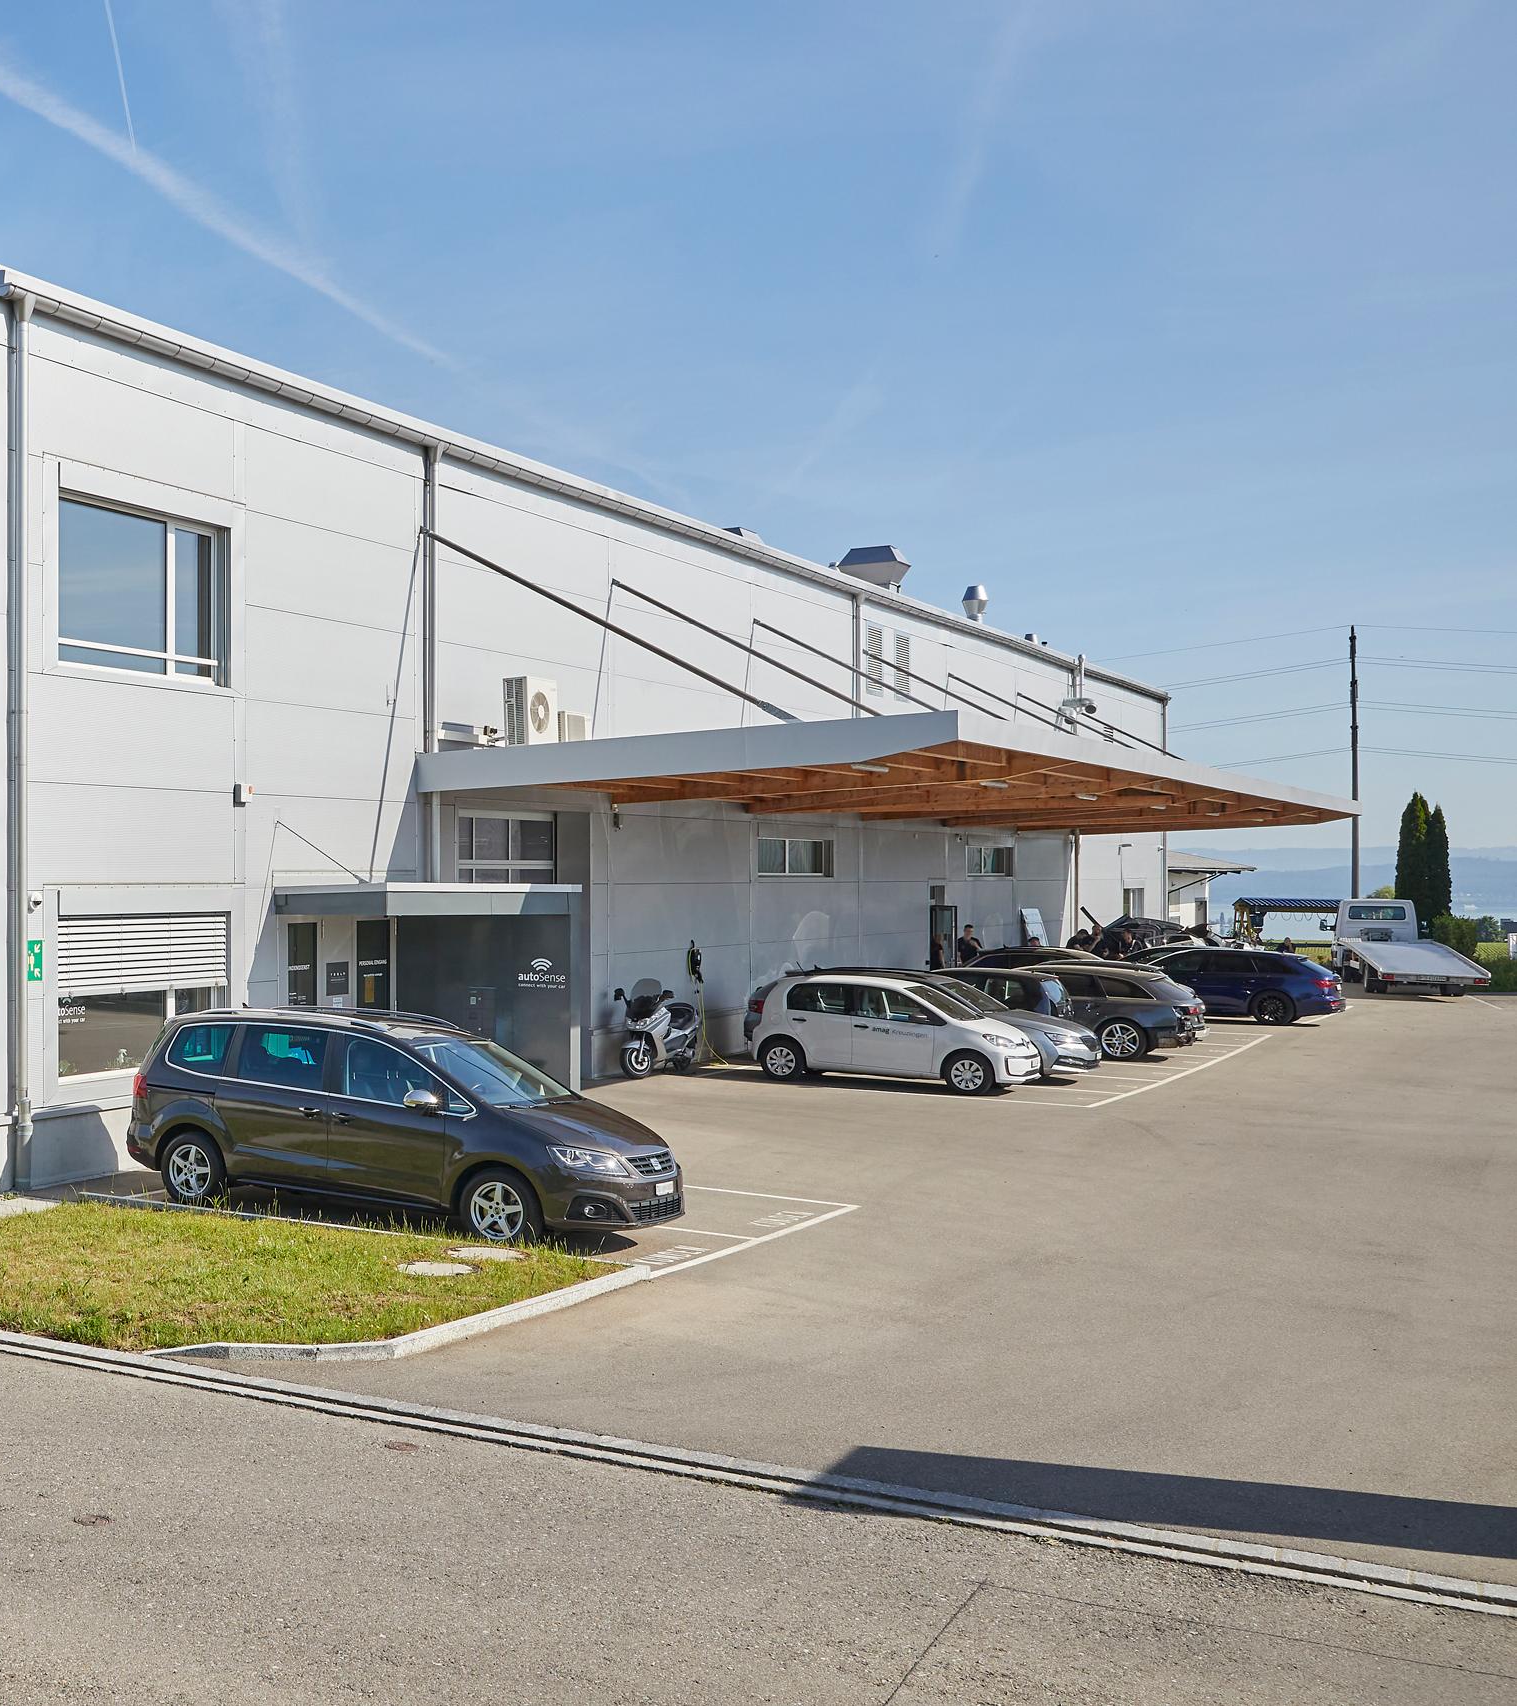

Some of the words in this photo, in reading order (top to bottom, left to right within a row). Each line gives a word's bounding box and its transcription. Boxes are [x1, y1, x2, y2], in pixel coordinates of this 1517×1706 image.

[518, 972, 566, 983] autoSense
[58, 1004, 86, 1016] toSense
[872, 1026, 890, 1035] amag
